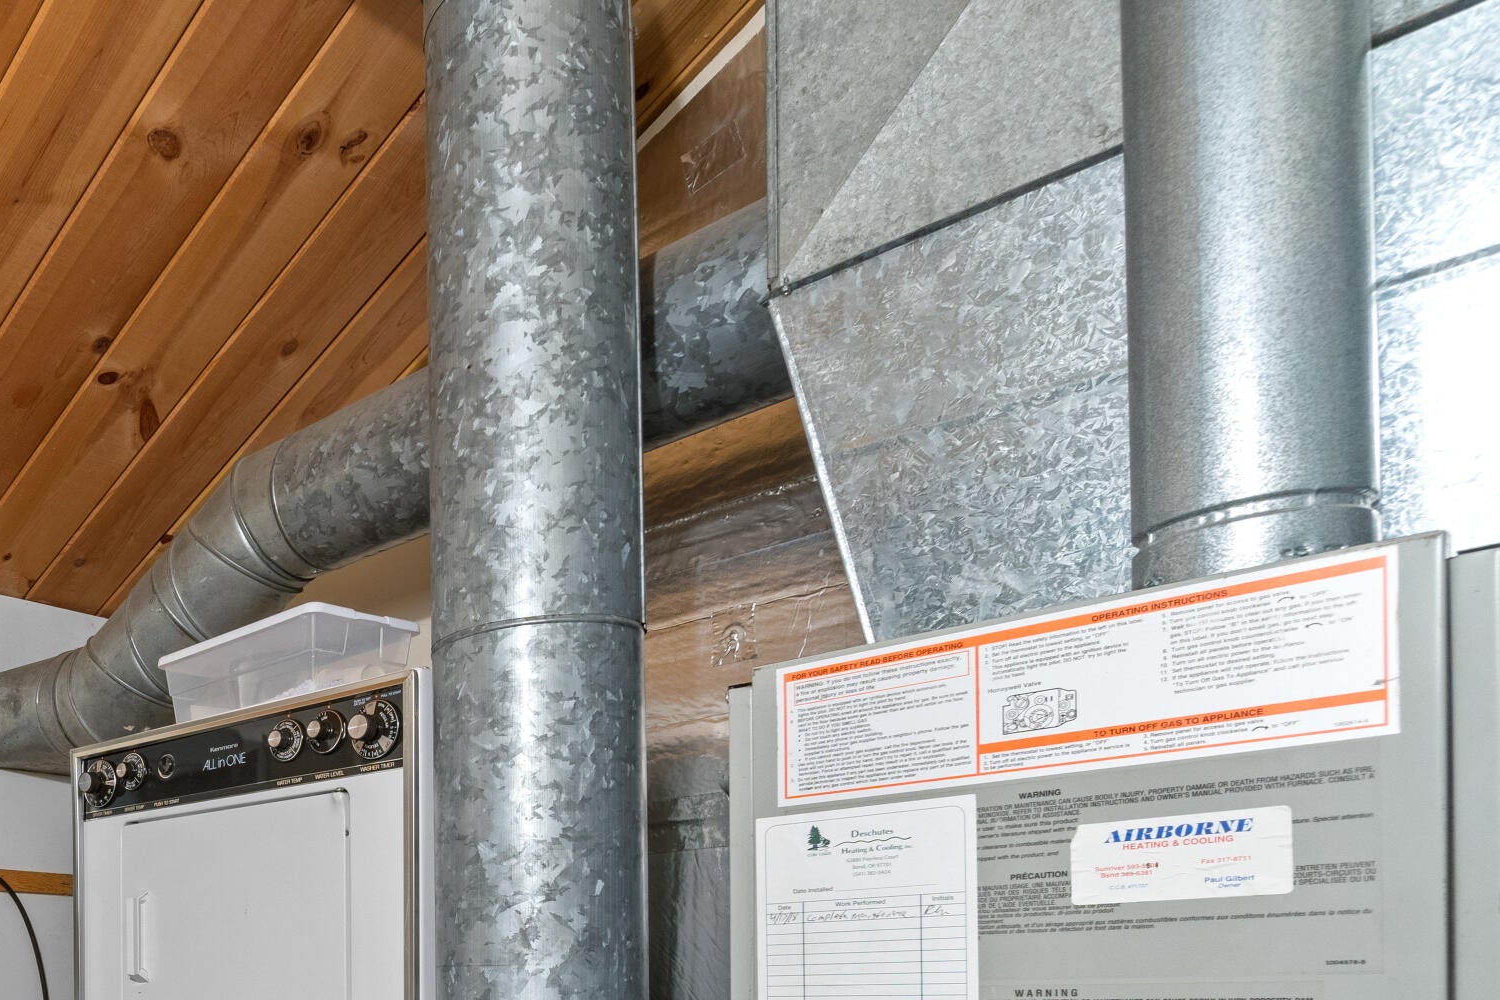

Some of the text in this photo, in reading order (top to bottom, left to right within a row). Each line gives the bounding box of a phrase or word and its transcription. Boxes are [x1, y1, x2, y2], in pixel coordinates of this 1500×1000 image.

[1092, 590, 1227, 622] OPERATING INSTRUCTIONS
[792, 642, 963, 681] FOR YOUR SAFETY READ BEFORE OPERATING
[988, 681, 1041, 694] Honeywell Valve
[1094, 708, 1263, 737] TO TURN OFF GAS TO APPLIANCE
[210, 743, 239, 753] Kenmore
[360, 764, 379, 772] WASHER
[1019, 789, 1061, 799] WARNING
[851, 829, 893, 837] Deschutes
[1105, 818, 1254, 843] AIRBORNE
[1122, 838, 1169, 850] HEATING
[1183, 835, 1234, 846] COOLING
[1010, 871, 1068, 881] PRÉCAUTION
[1015, 989, 1078, 997] WARNING
